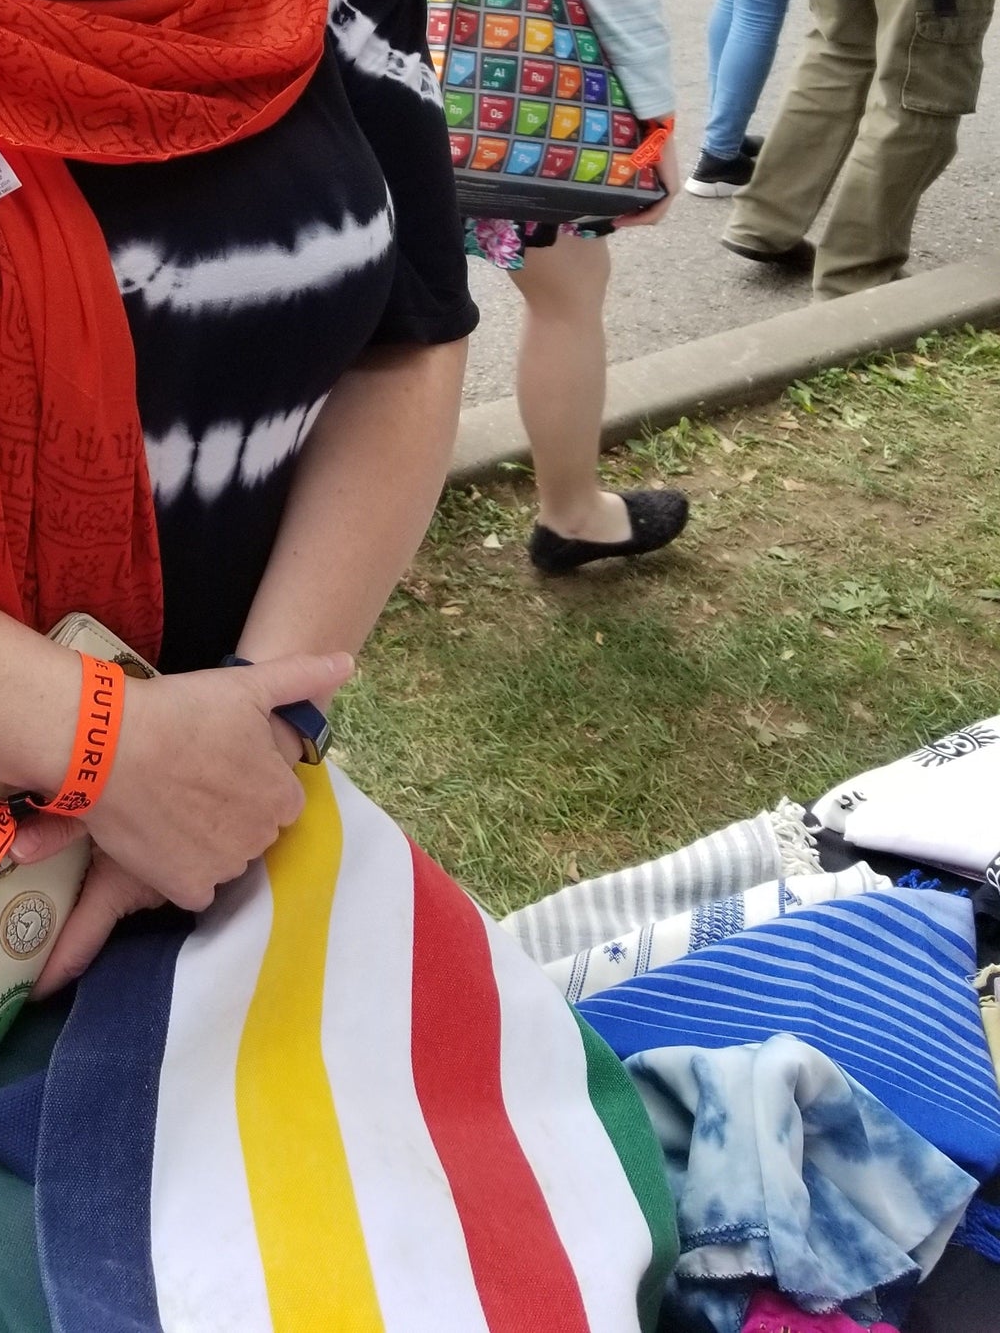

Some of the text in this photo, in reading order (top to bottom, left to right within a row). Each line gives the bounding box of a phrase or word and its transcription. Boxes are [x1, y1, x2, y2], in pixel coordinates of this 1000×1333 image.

[493, 68, 505, 78] Al
[531, 72, 545, 83] Ru
[482, 149, 498, 159] Sm
[555, 157, 564, 167] V
[77, 673, 113, 784] FUTURE
